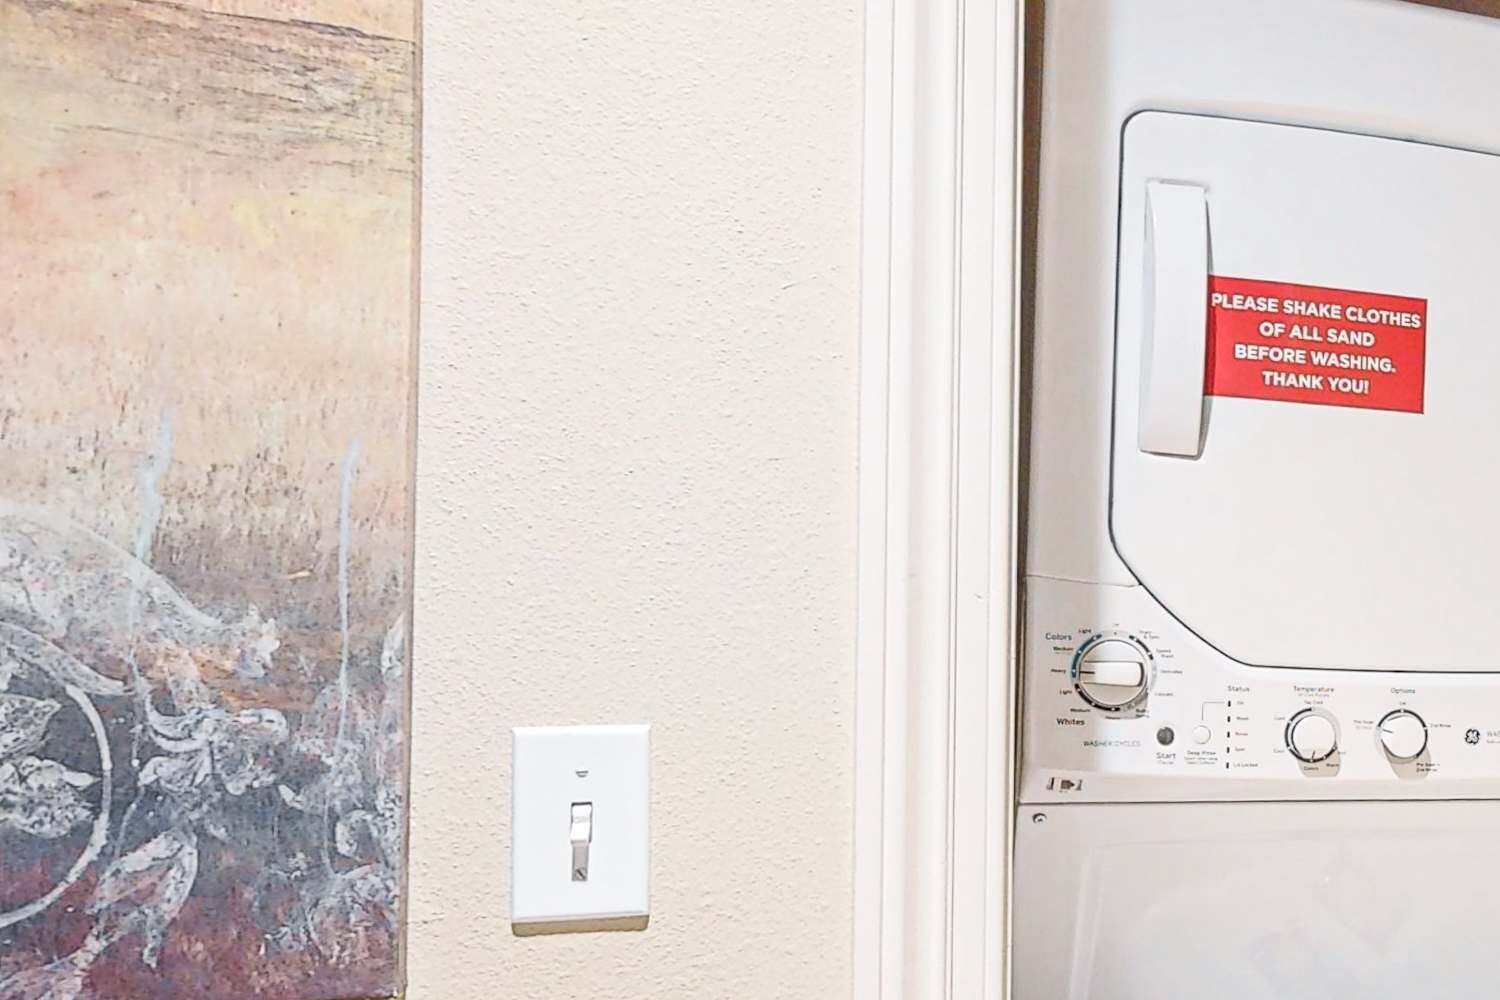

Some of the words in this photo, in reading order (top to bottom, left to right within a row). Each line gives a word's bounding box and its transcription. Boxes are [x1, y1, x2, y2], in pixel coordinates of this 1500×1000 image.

[1211, 292, 1279, 313] PLEASE
[1282, 300, 1341, 319] SHAKE
[1345, 307, 1422, 329] CLOTHES
[1259, 321, 1285, 338] OF
[1289, 324, 1323, 342] ALL
[1326, 328, 1375, 347] SAND
[1234, 344, 1306, 364] BEFORE
[1310, 351, 1397, 373] WASHING.
[1262, 371, 1324, 390] THANK
[1327, 377, 1370, 394] YOU!
[1045, 632, 1072, 641] Colors
[1293, 685, 1335, 694] Temperature
[1056, 718, 1086, 726] Whites
[1155, 752, 1176, 760] Start
